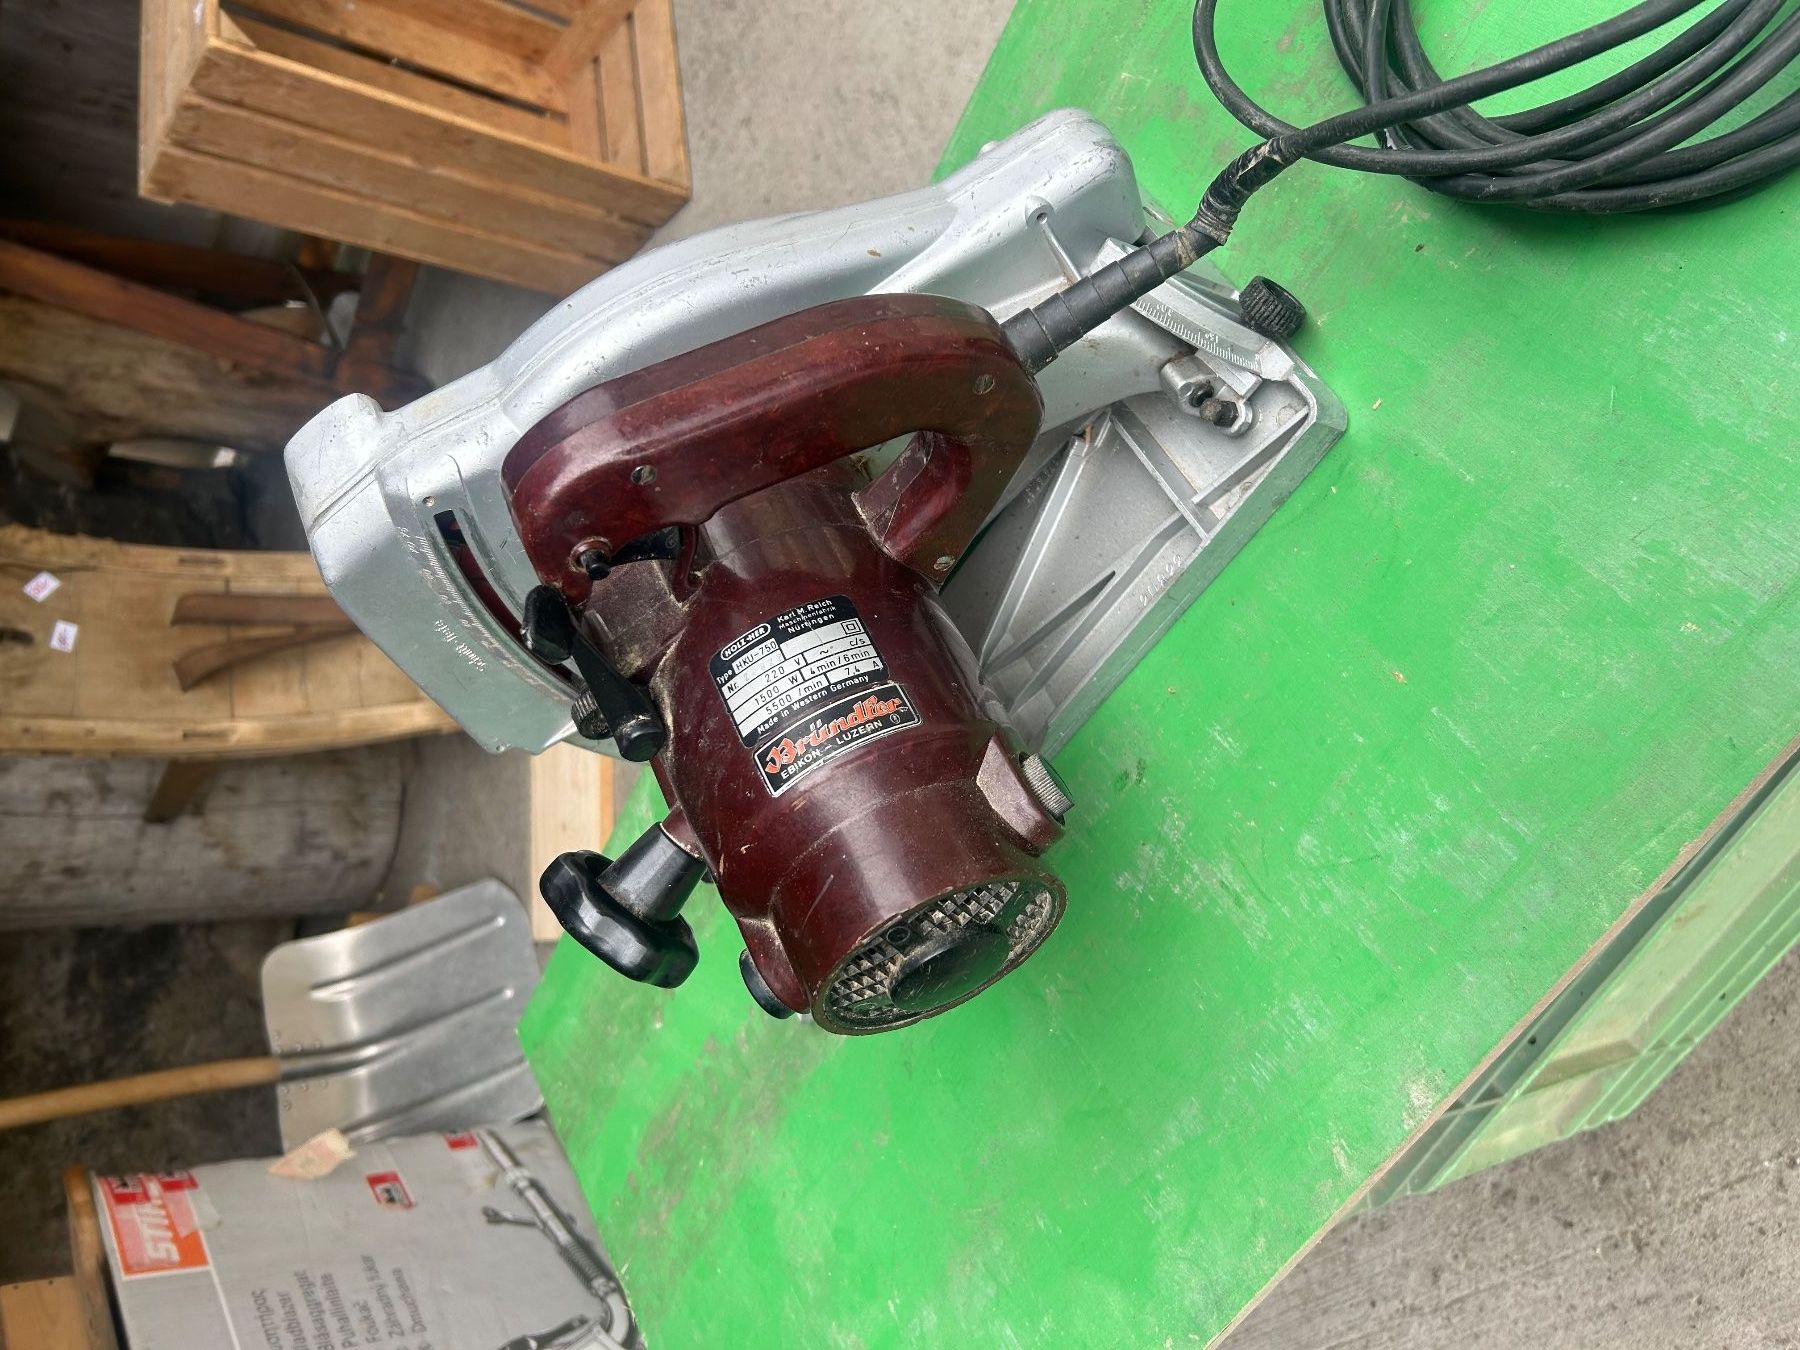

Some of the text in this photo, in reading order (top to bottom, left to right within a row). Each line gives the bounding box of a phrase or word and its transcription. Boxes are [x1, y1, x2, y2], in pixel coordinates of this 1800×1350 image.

[777, 611, 797, 623] Karl
[807, 599, 833, 611] Reich
[779, 605, 837, 630] Maschinenfabrik
[787, 613, 835, 634] Nürtingen
[849, 637, 866, 647] c/s
[716, 669, 733, 685] Type
[735, 640, 777, 671] HKU-750
[764, 665, 785, 683] 220
[794, 657, 801, 666] V
[871, 660, 880, 669] A
[754, 673, 799, 706] 1500 W
[757, 675, 869, 735] Made in Western Germany
[765, 694, 793, 715] 5500
[780, 748, 822, 780] EBIKON
[835, 720, 883, 745] LUZERN
